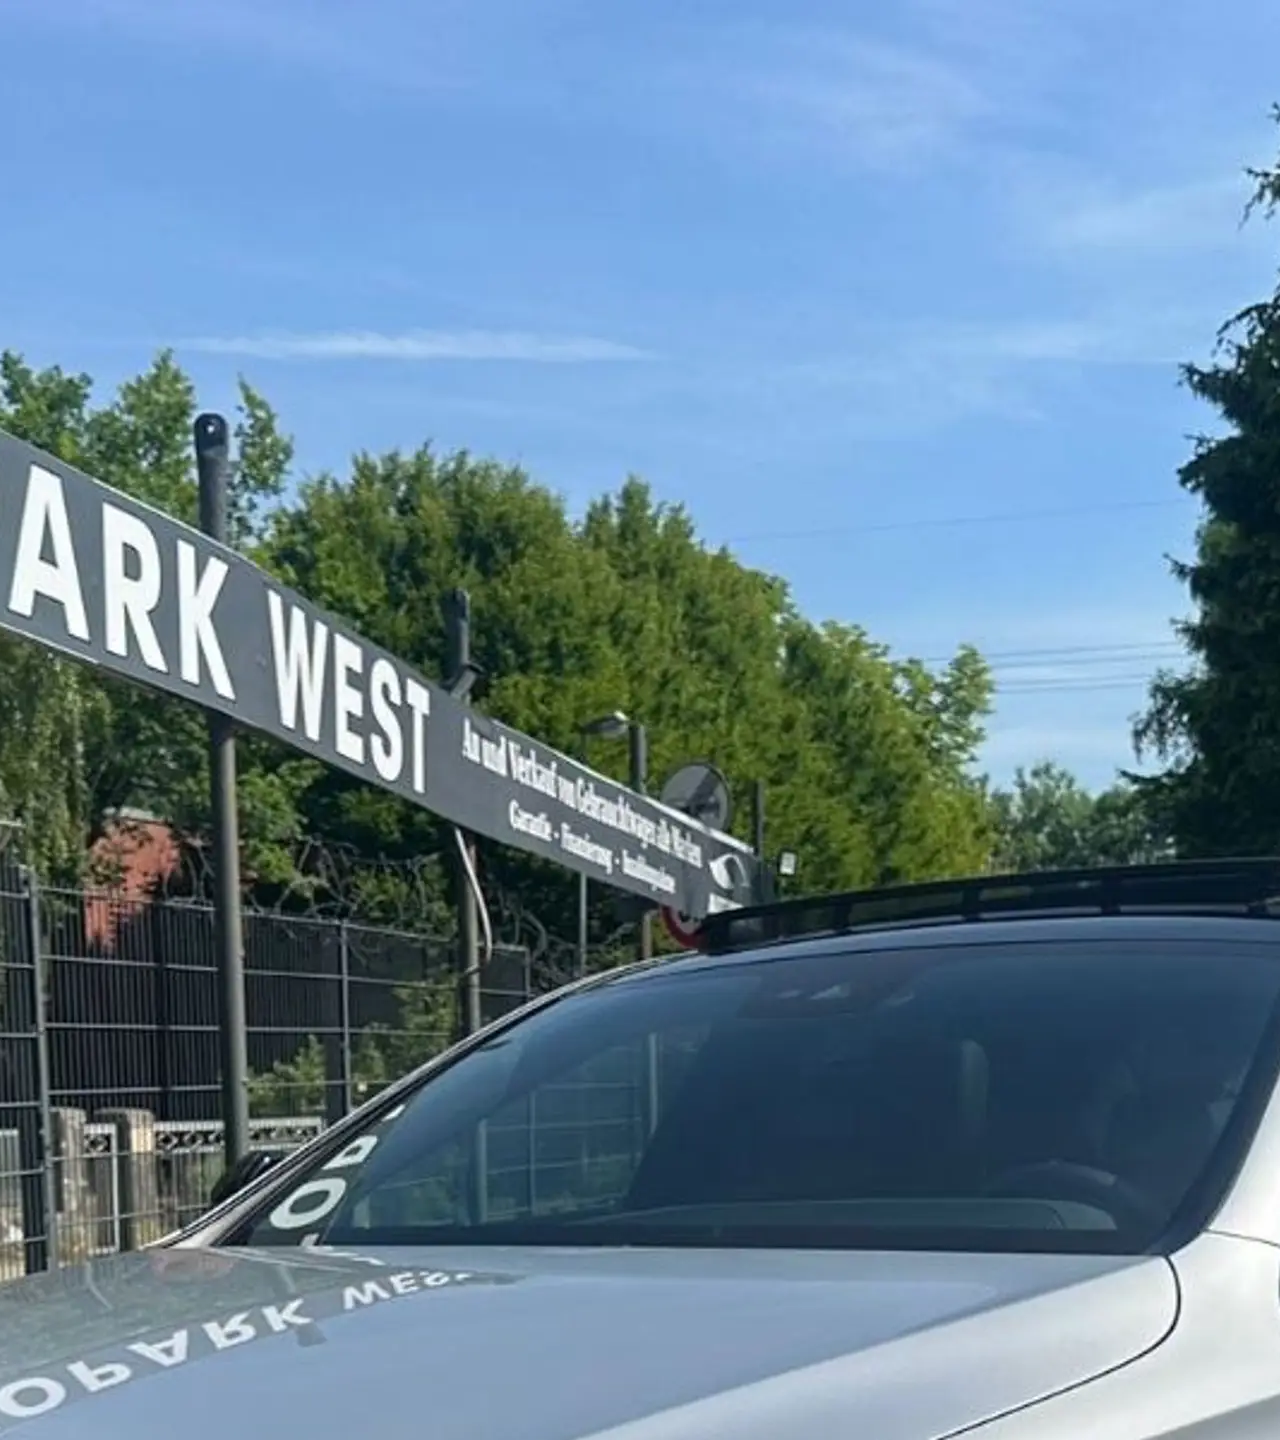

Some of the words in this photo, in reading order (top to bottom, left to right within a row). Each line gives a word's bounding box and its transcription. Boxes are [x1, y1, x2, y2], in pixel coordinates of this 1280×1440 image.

[267, 589, 431, 795] WEST
[481, 734, 508, 778] und
[508, 740, 558, 799] Verkauf
[508, 798, 553, 842] Garantie
